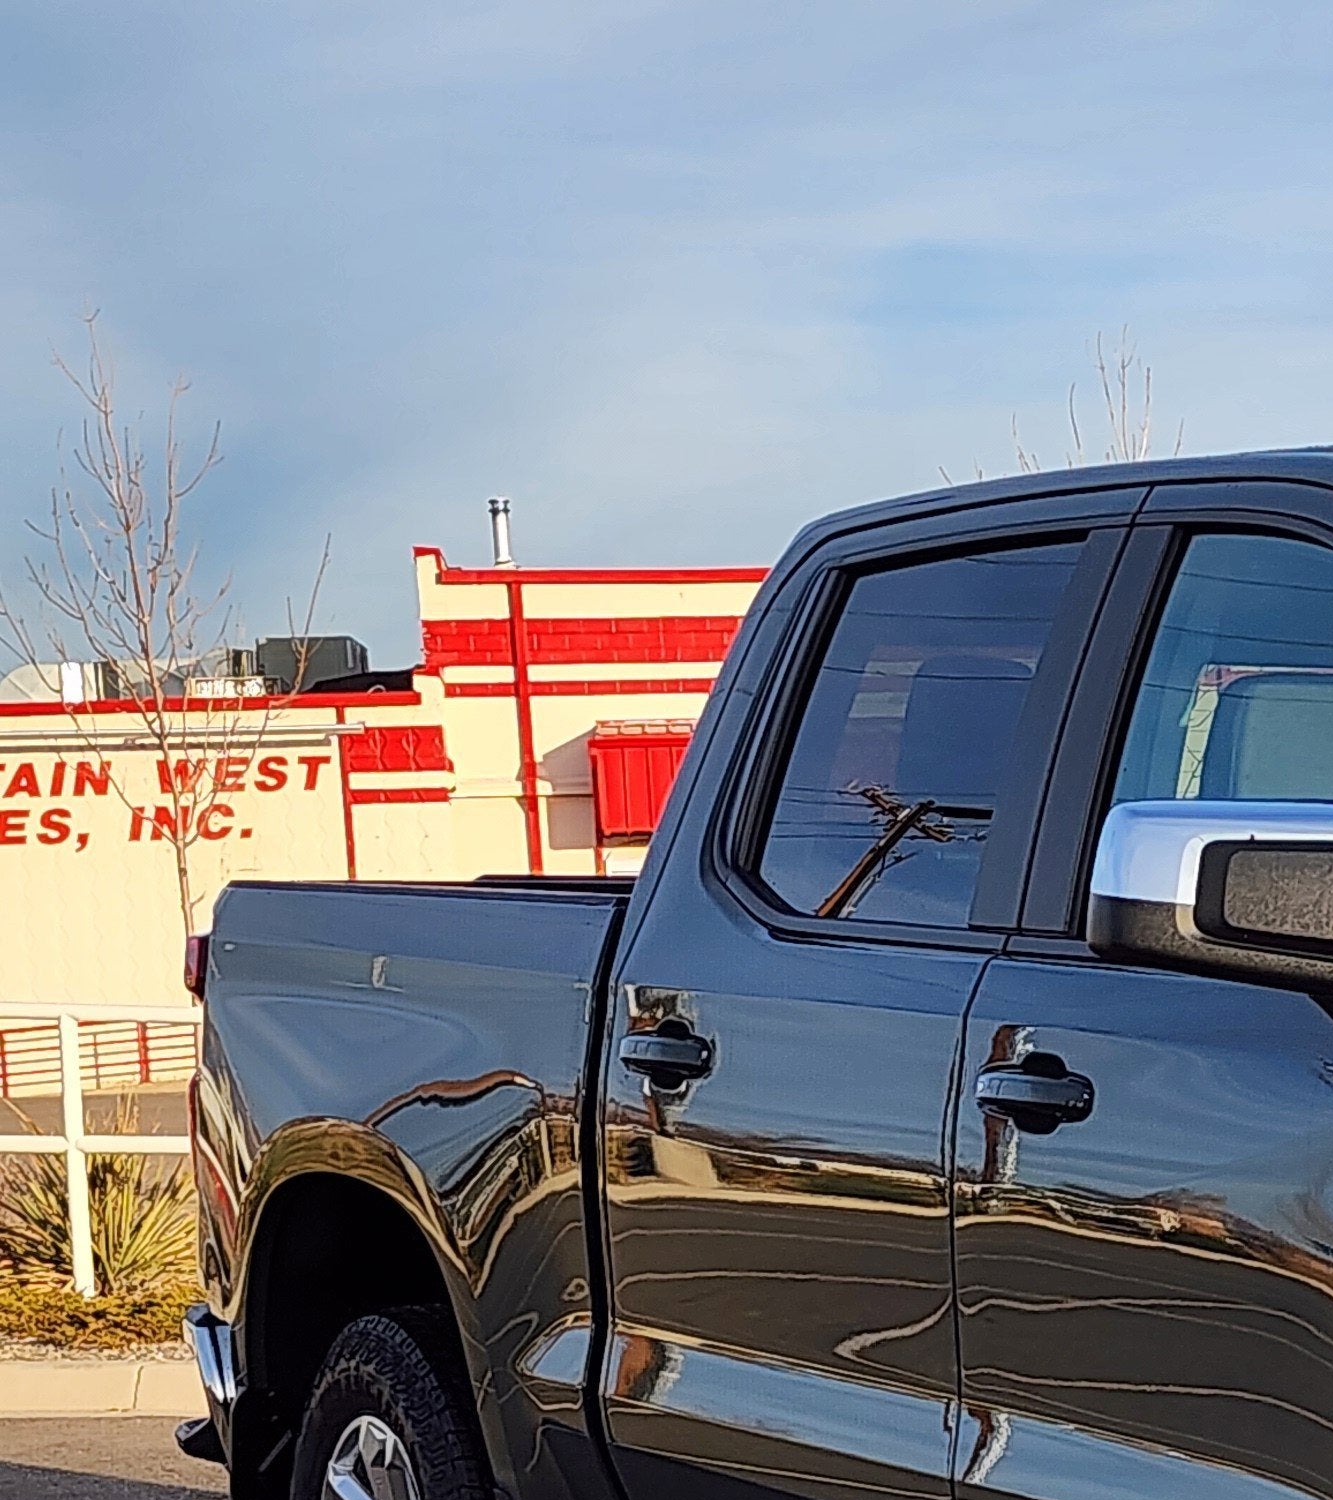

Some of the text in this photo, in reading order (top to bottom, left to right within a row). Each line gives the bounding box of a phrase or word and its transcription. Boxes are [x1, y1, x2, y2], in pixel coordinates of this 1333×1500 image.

[0, 755, 331, 798] AIN WEST
[128, 803, 254, 842] INC.
